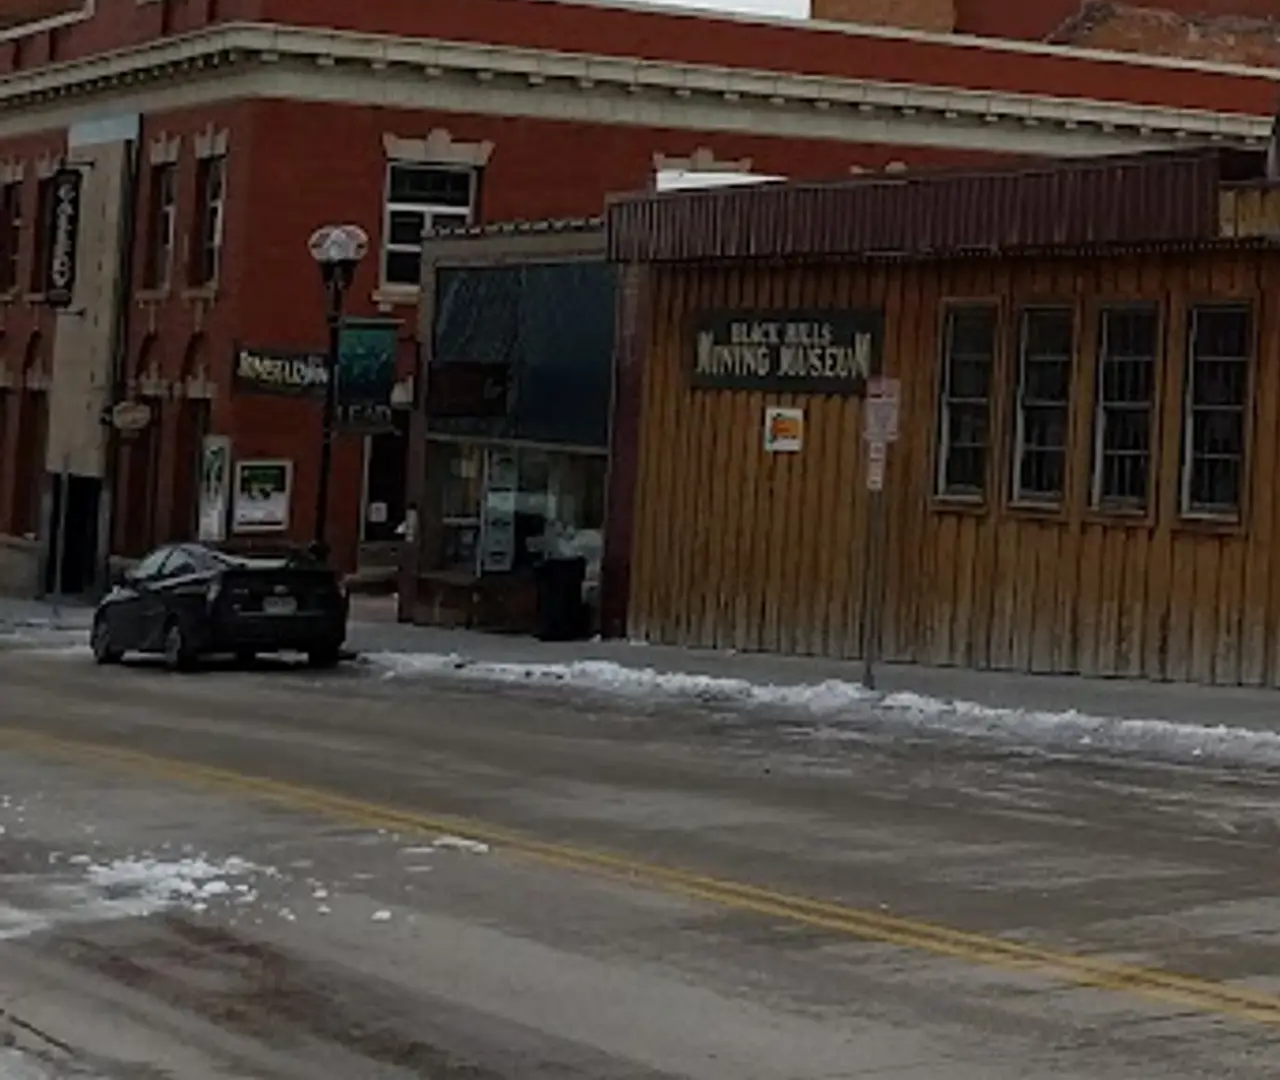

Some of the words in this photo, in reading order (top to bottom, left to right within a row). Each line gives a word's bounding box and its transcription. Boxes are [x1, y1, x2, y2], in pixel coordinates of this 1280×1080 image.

[731, 323, 779, 344] BLACK
[785, 323, 834, 346] HILLS
[696, 331, 770, 377] MINING
[777, 332, 871, 379] MUSEUM
